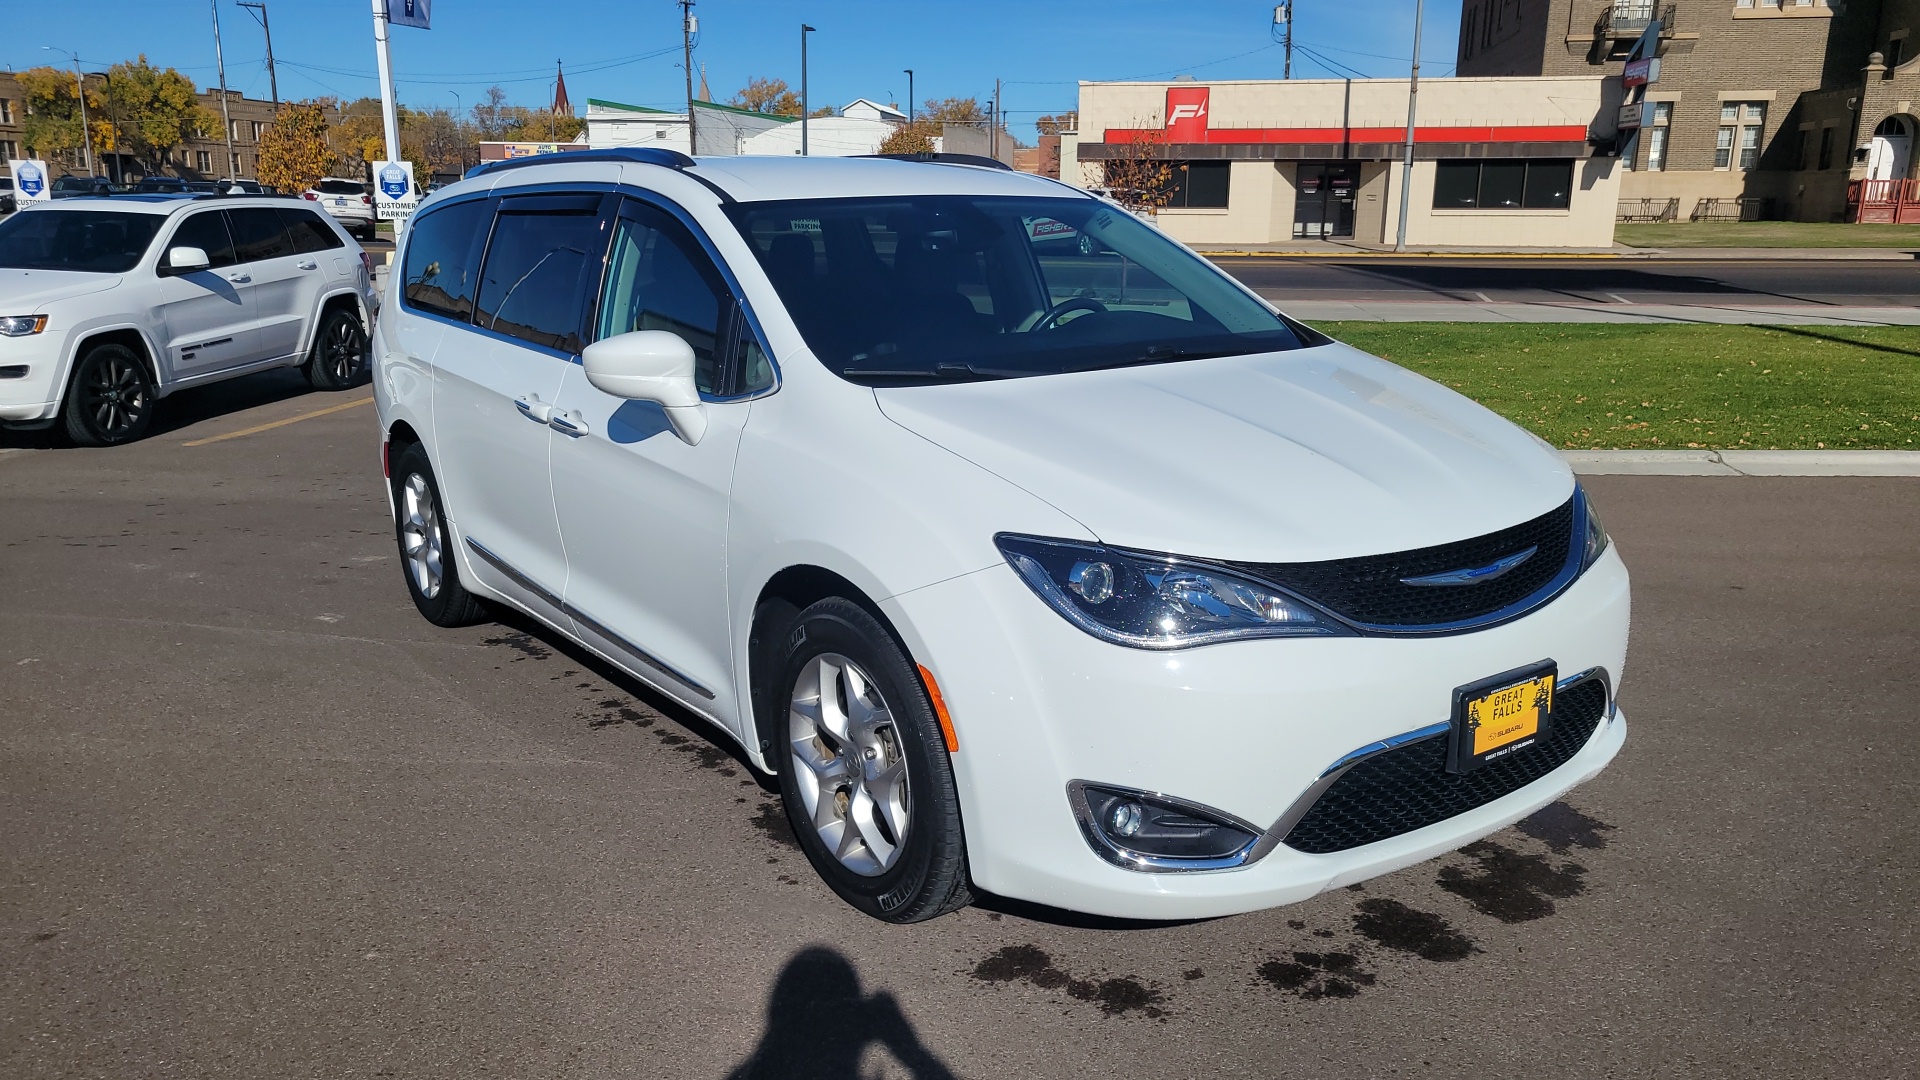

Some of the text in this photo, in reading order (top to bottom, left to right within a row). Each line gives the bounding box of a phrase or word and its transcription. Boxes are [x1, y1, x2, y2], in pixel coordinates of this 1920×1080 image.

[1494, 688, 1525, 707] GREAT
[1492, 700, 1523, 721] FALLS
[1497, 723, 1524, 737] SUBARU
